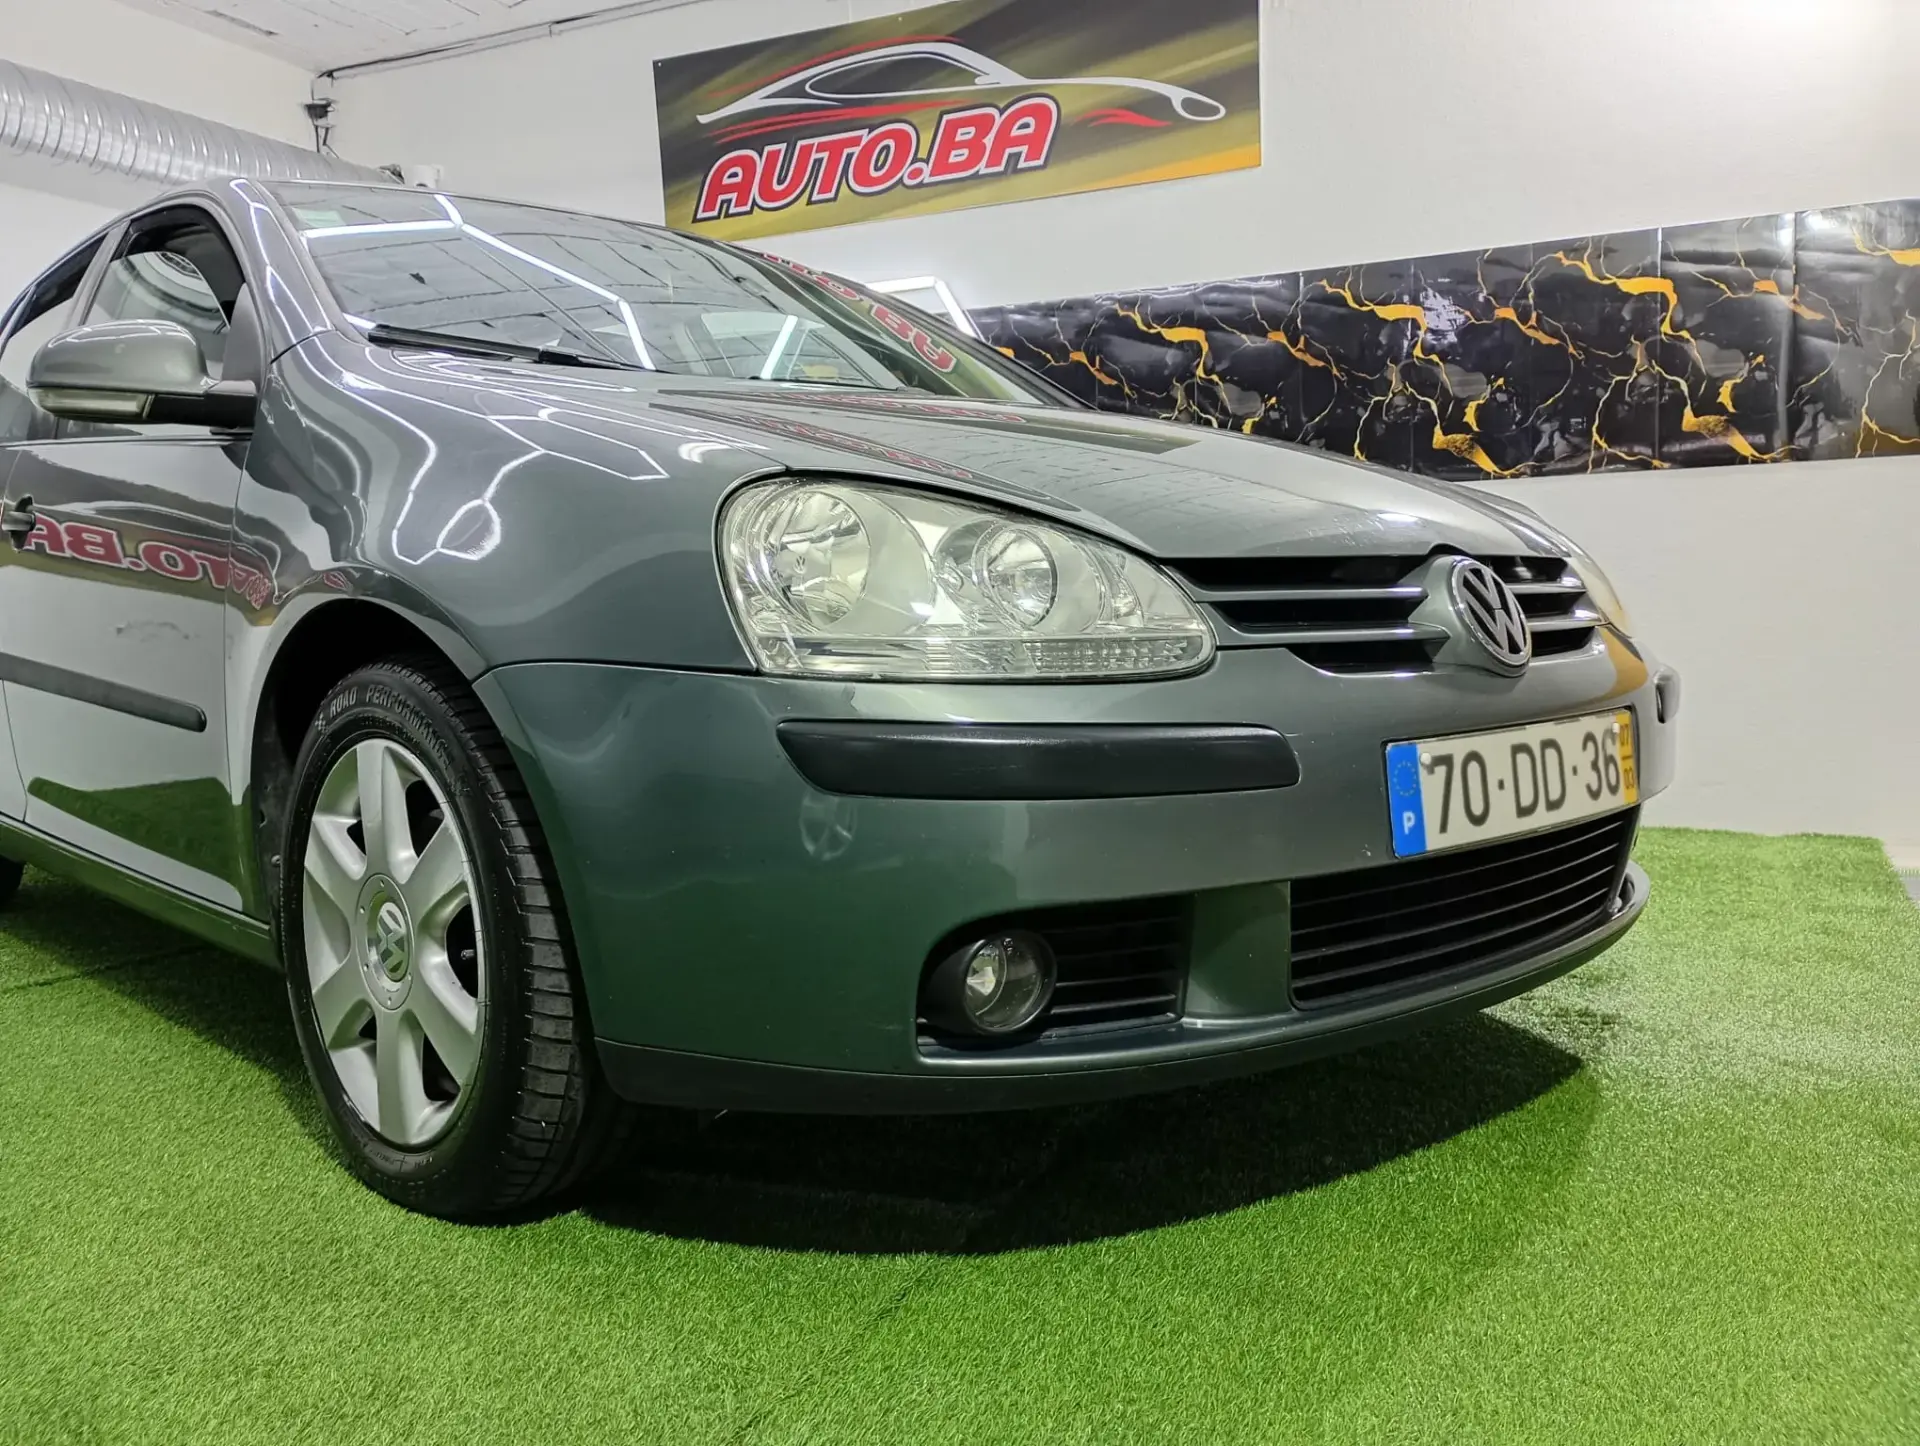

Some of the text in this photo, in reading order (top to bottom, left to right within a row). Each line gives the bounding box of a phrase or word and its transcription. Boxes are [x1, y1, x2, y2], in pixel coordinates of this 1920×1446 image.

[695, 96, 1059, 221] AUTO.BA
[329, 686, 358, 718] ROAD
[1402, 810, 1416, 835] P
